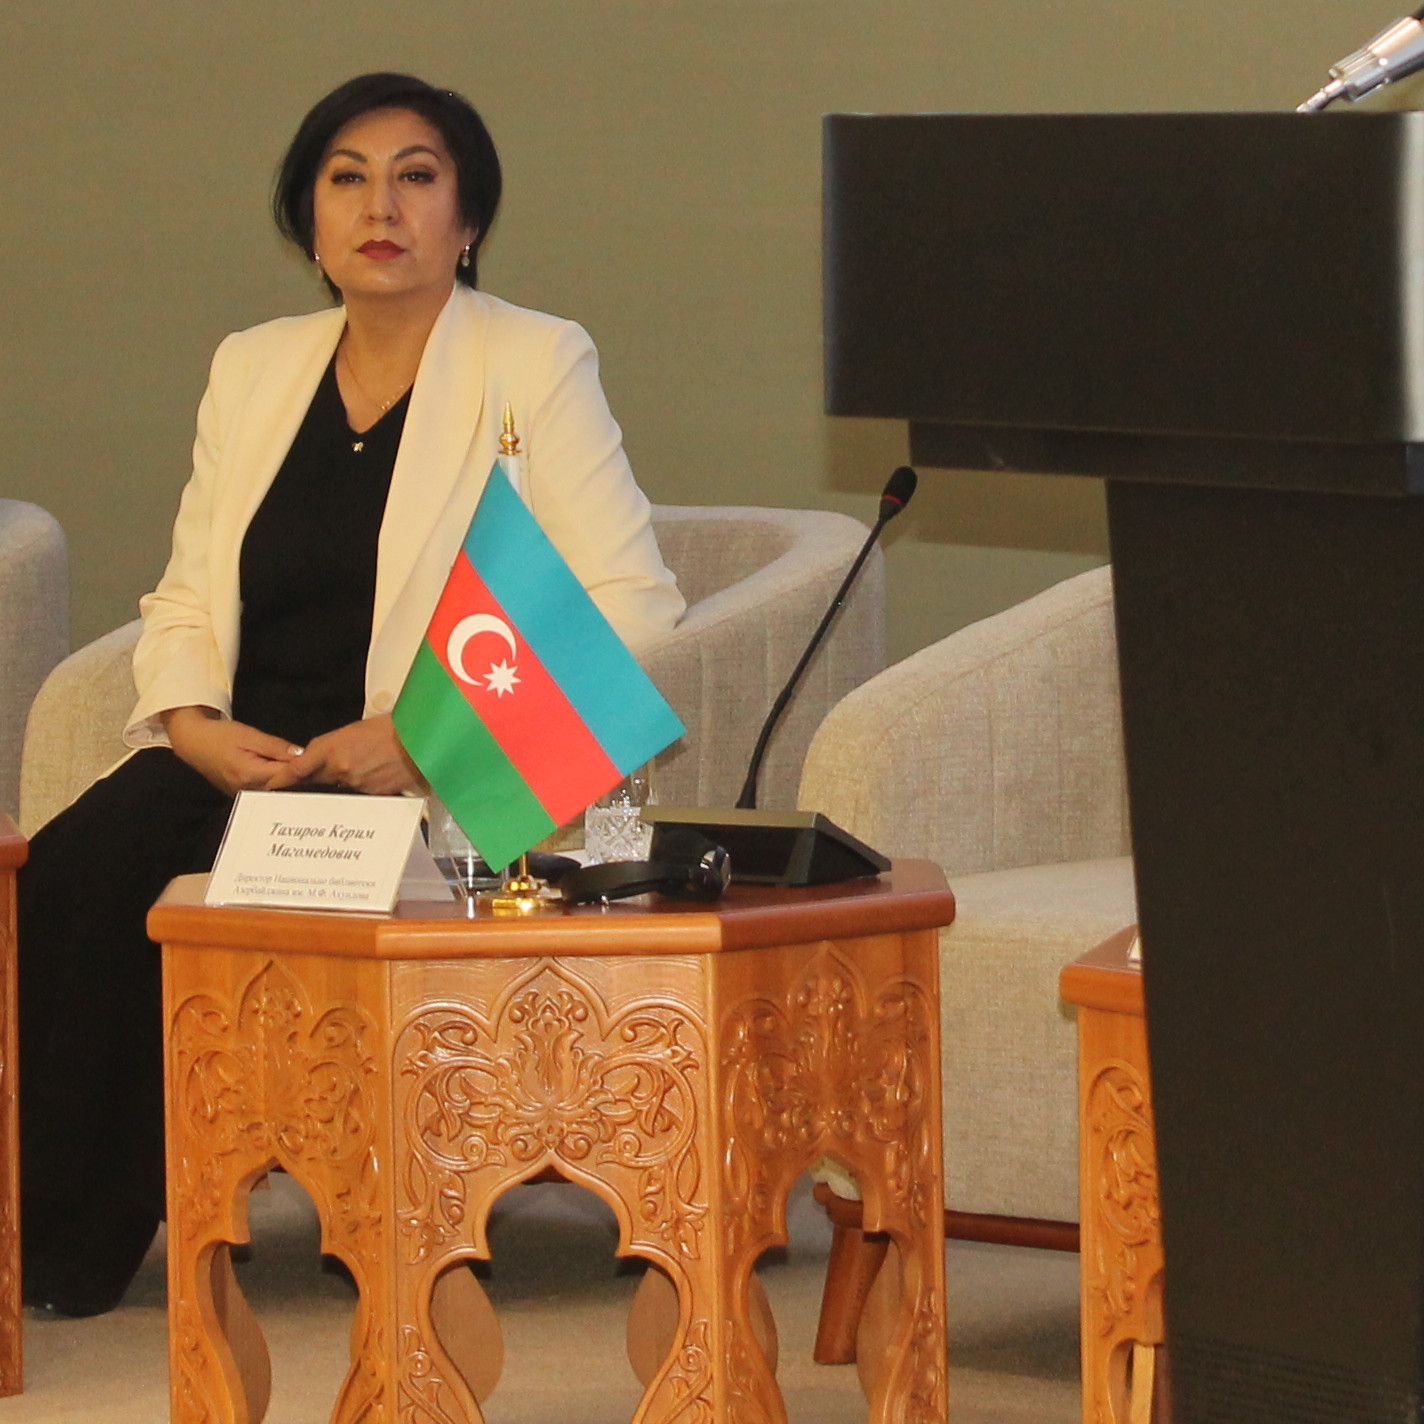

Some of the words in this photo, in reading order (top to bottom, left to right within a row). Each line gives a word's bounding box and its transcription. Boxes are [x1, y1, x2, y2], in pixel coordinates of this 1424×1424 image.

[269, 822, 326, 840] Тахиров
[328, 823, 375, 842] Керим
[266, 843, 362, 860] Магомедович
